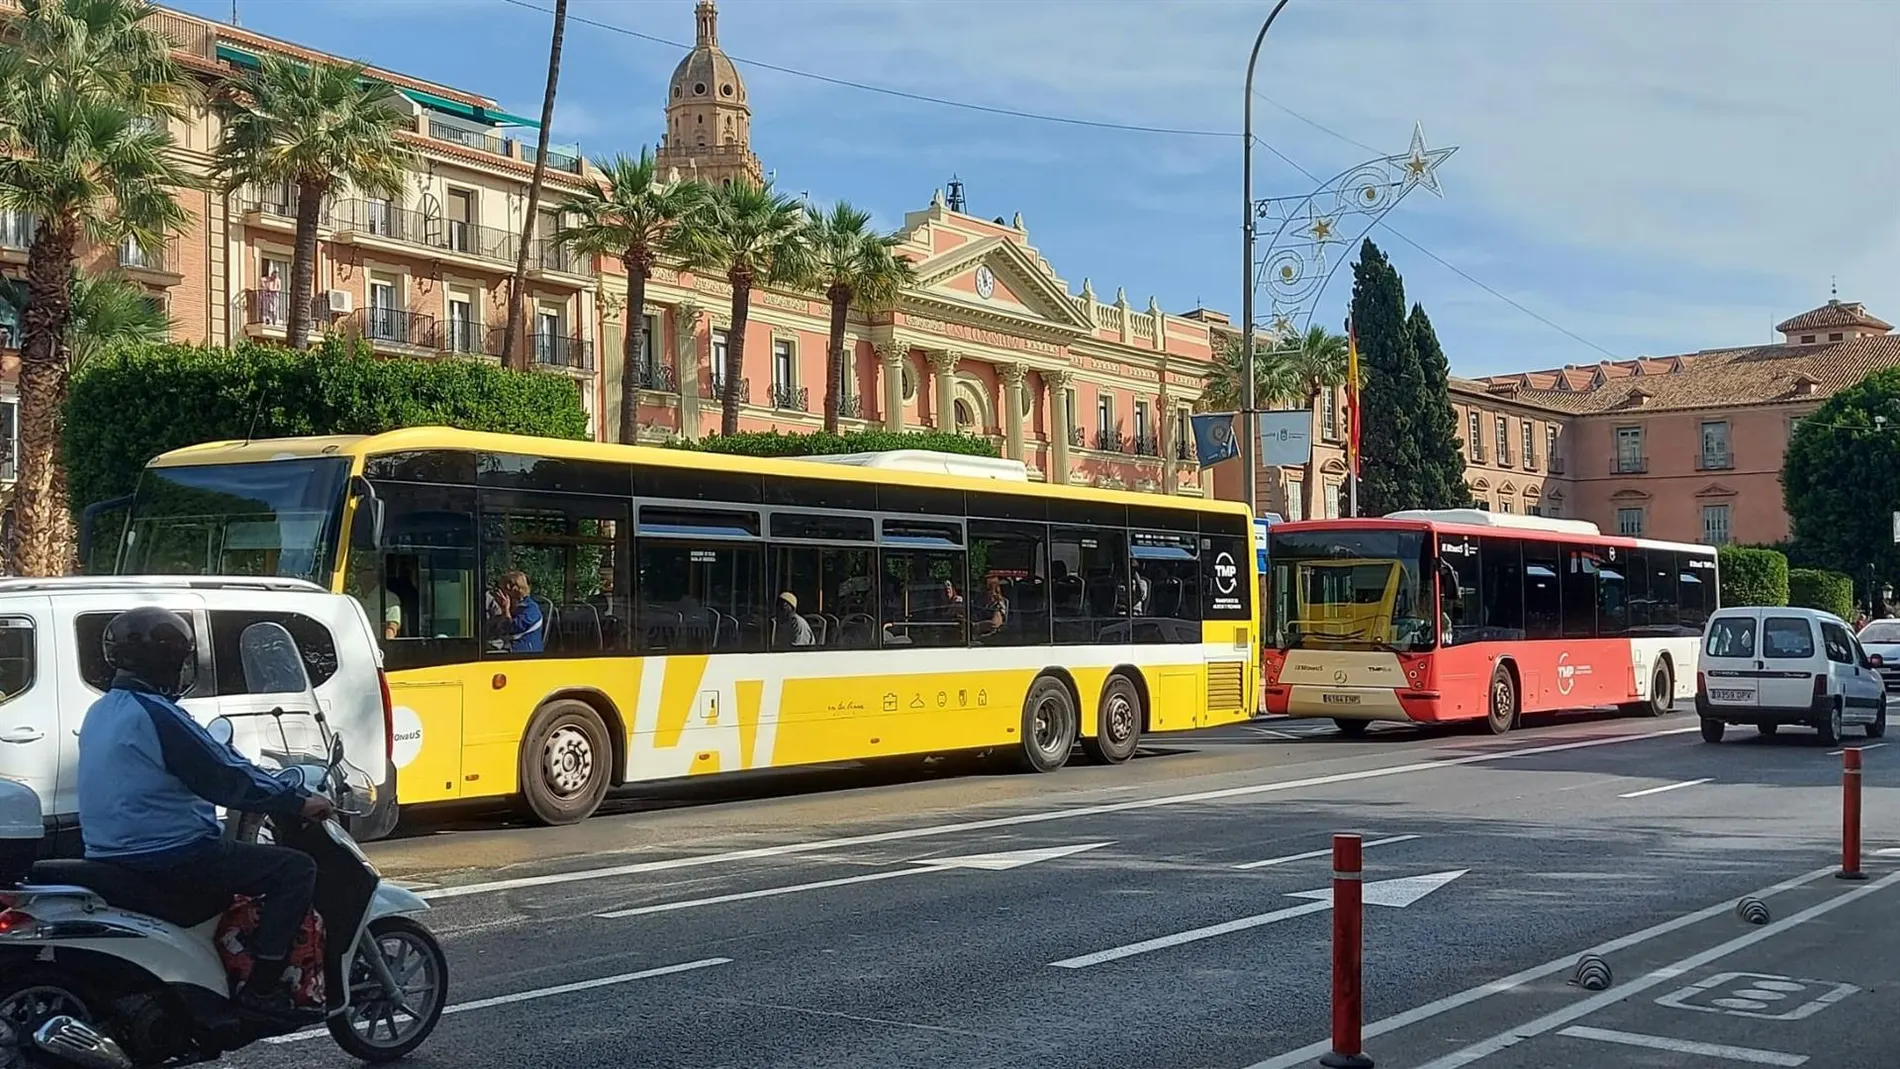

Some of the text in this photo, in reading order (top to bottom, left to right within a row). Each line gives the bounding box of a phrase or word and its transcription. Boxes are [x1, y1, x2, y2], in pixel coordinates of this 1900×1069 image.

[1214, 565, 1237, 577] TMP
[1557, 666, 1575, 678] TMP
[394, 729, 421, 742] ONBUS
